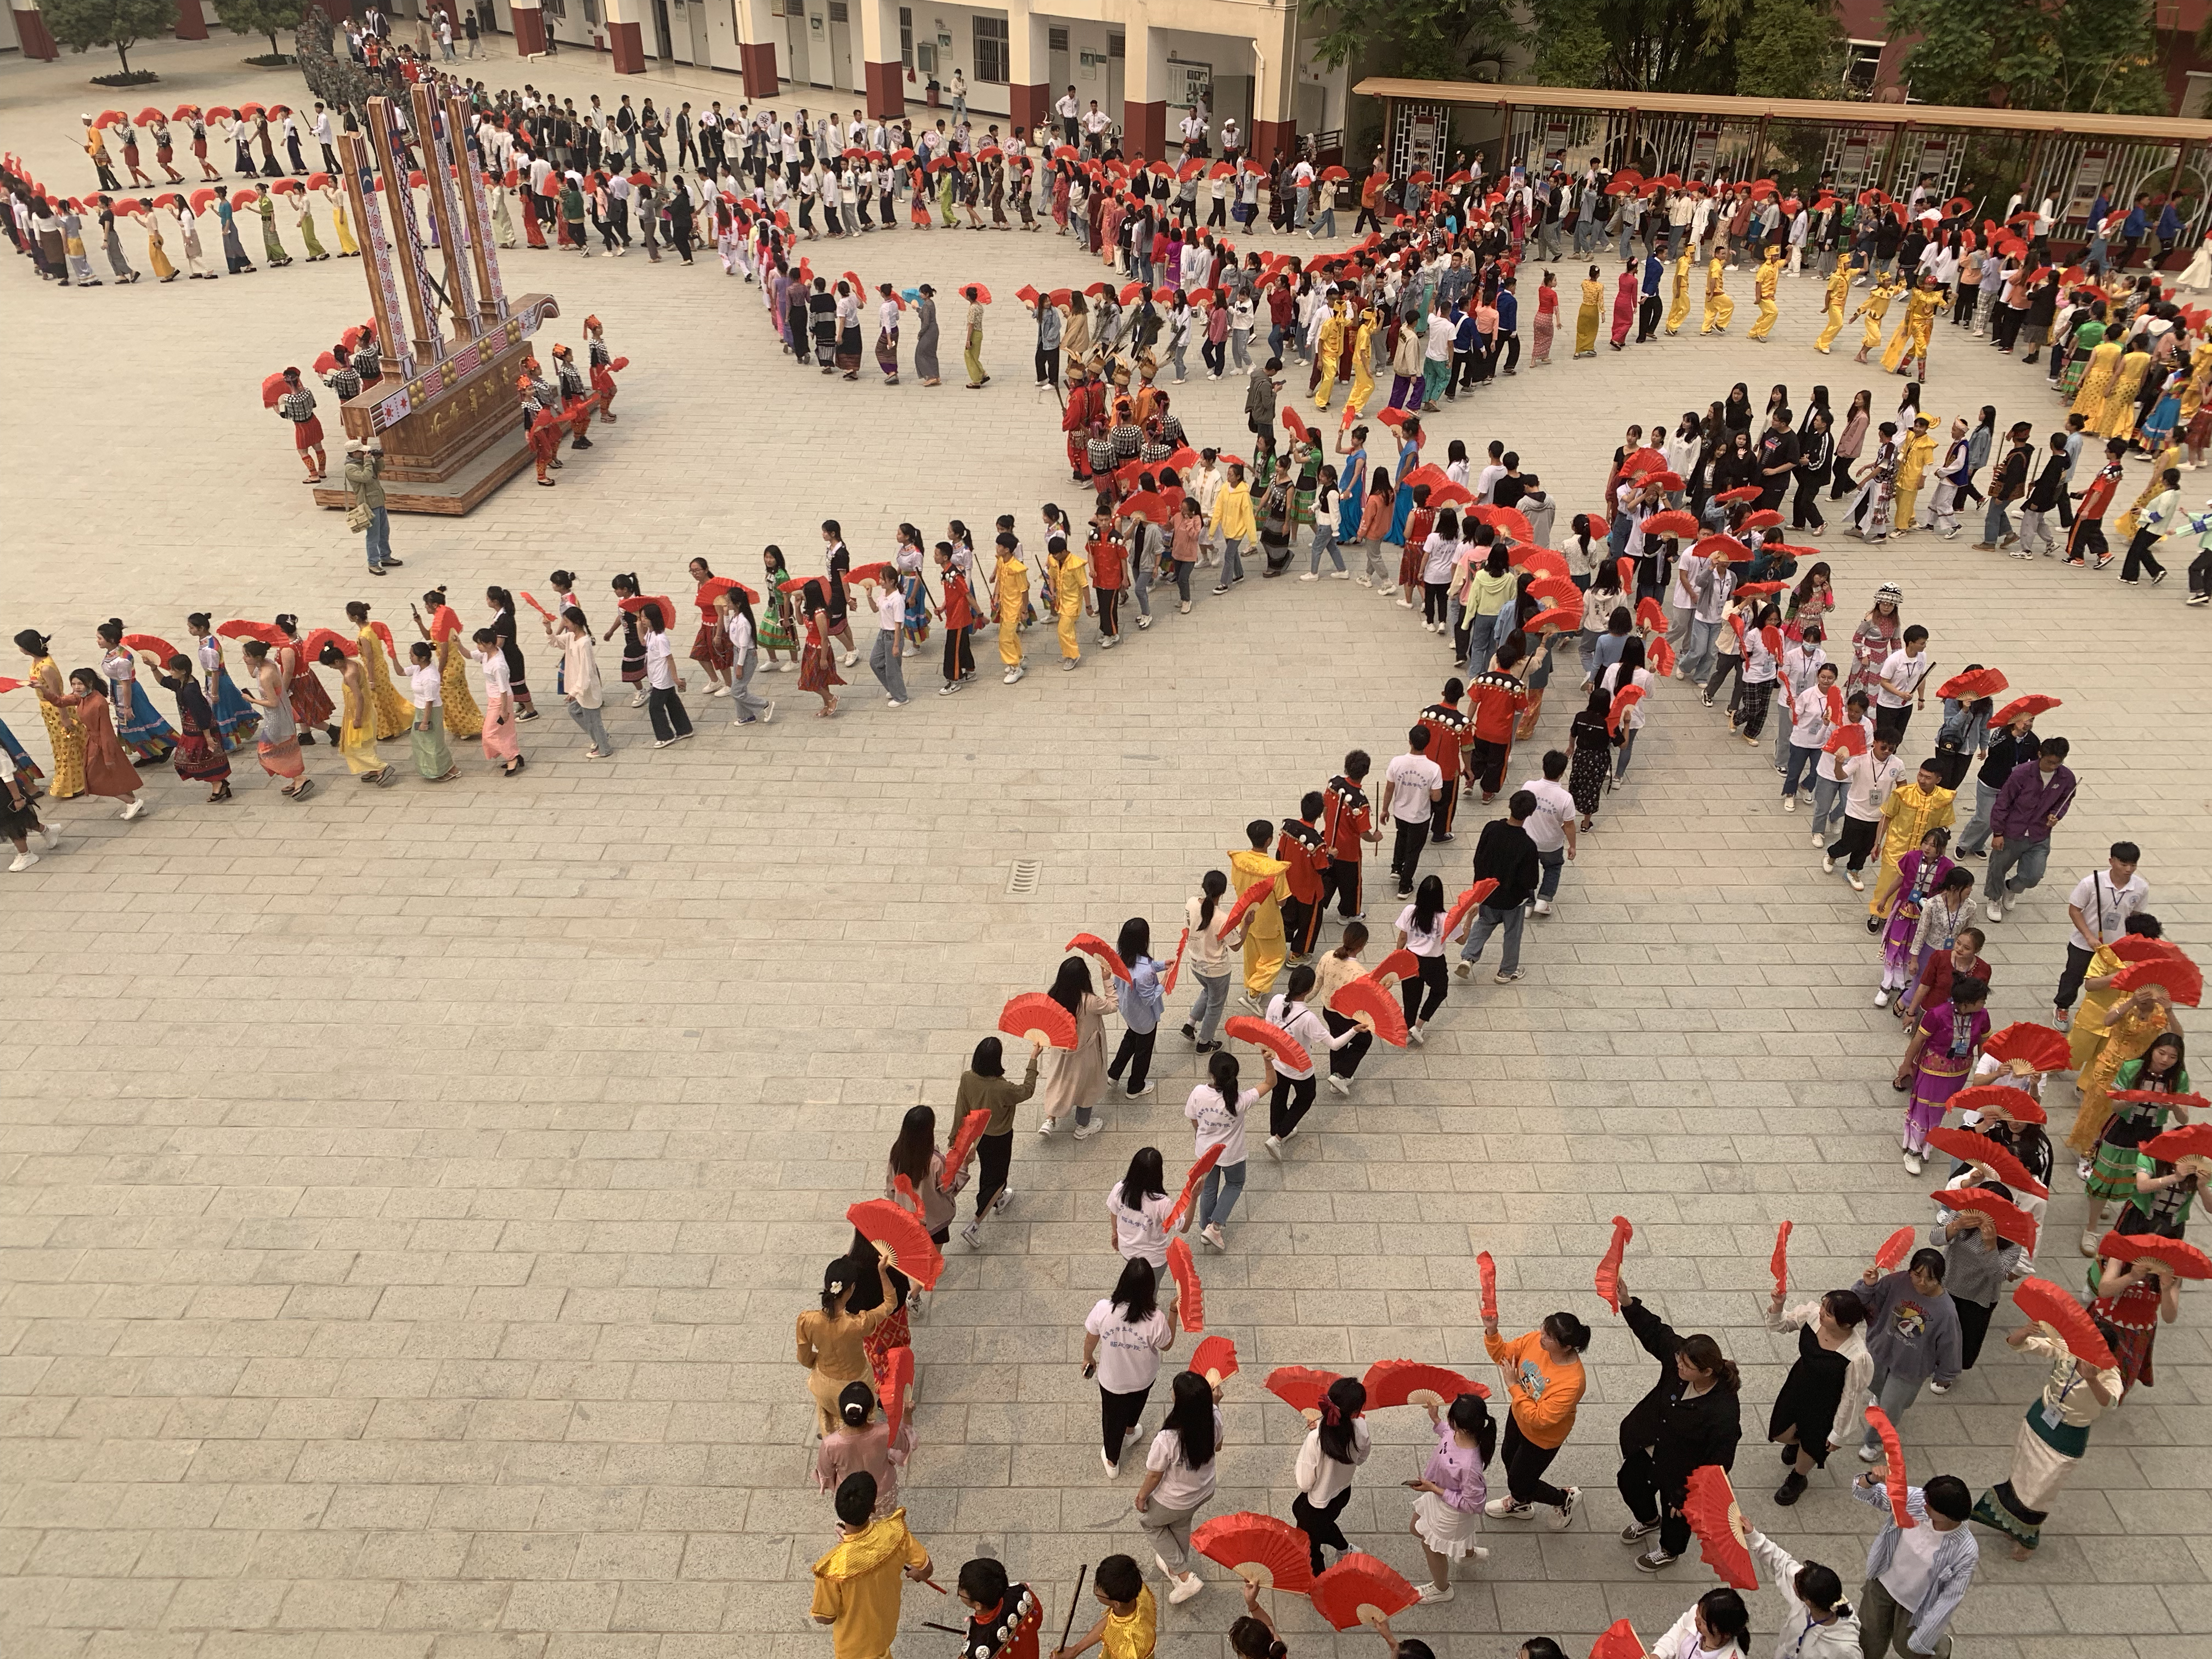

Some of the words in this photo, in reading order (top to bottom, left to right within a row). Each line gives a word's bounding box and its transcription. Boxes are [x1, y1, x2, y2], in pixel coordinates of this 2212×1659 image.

[1536, 805, 1553, 815] 床学院
[1110, 1341, 1141, 1351] 临床学院
